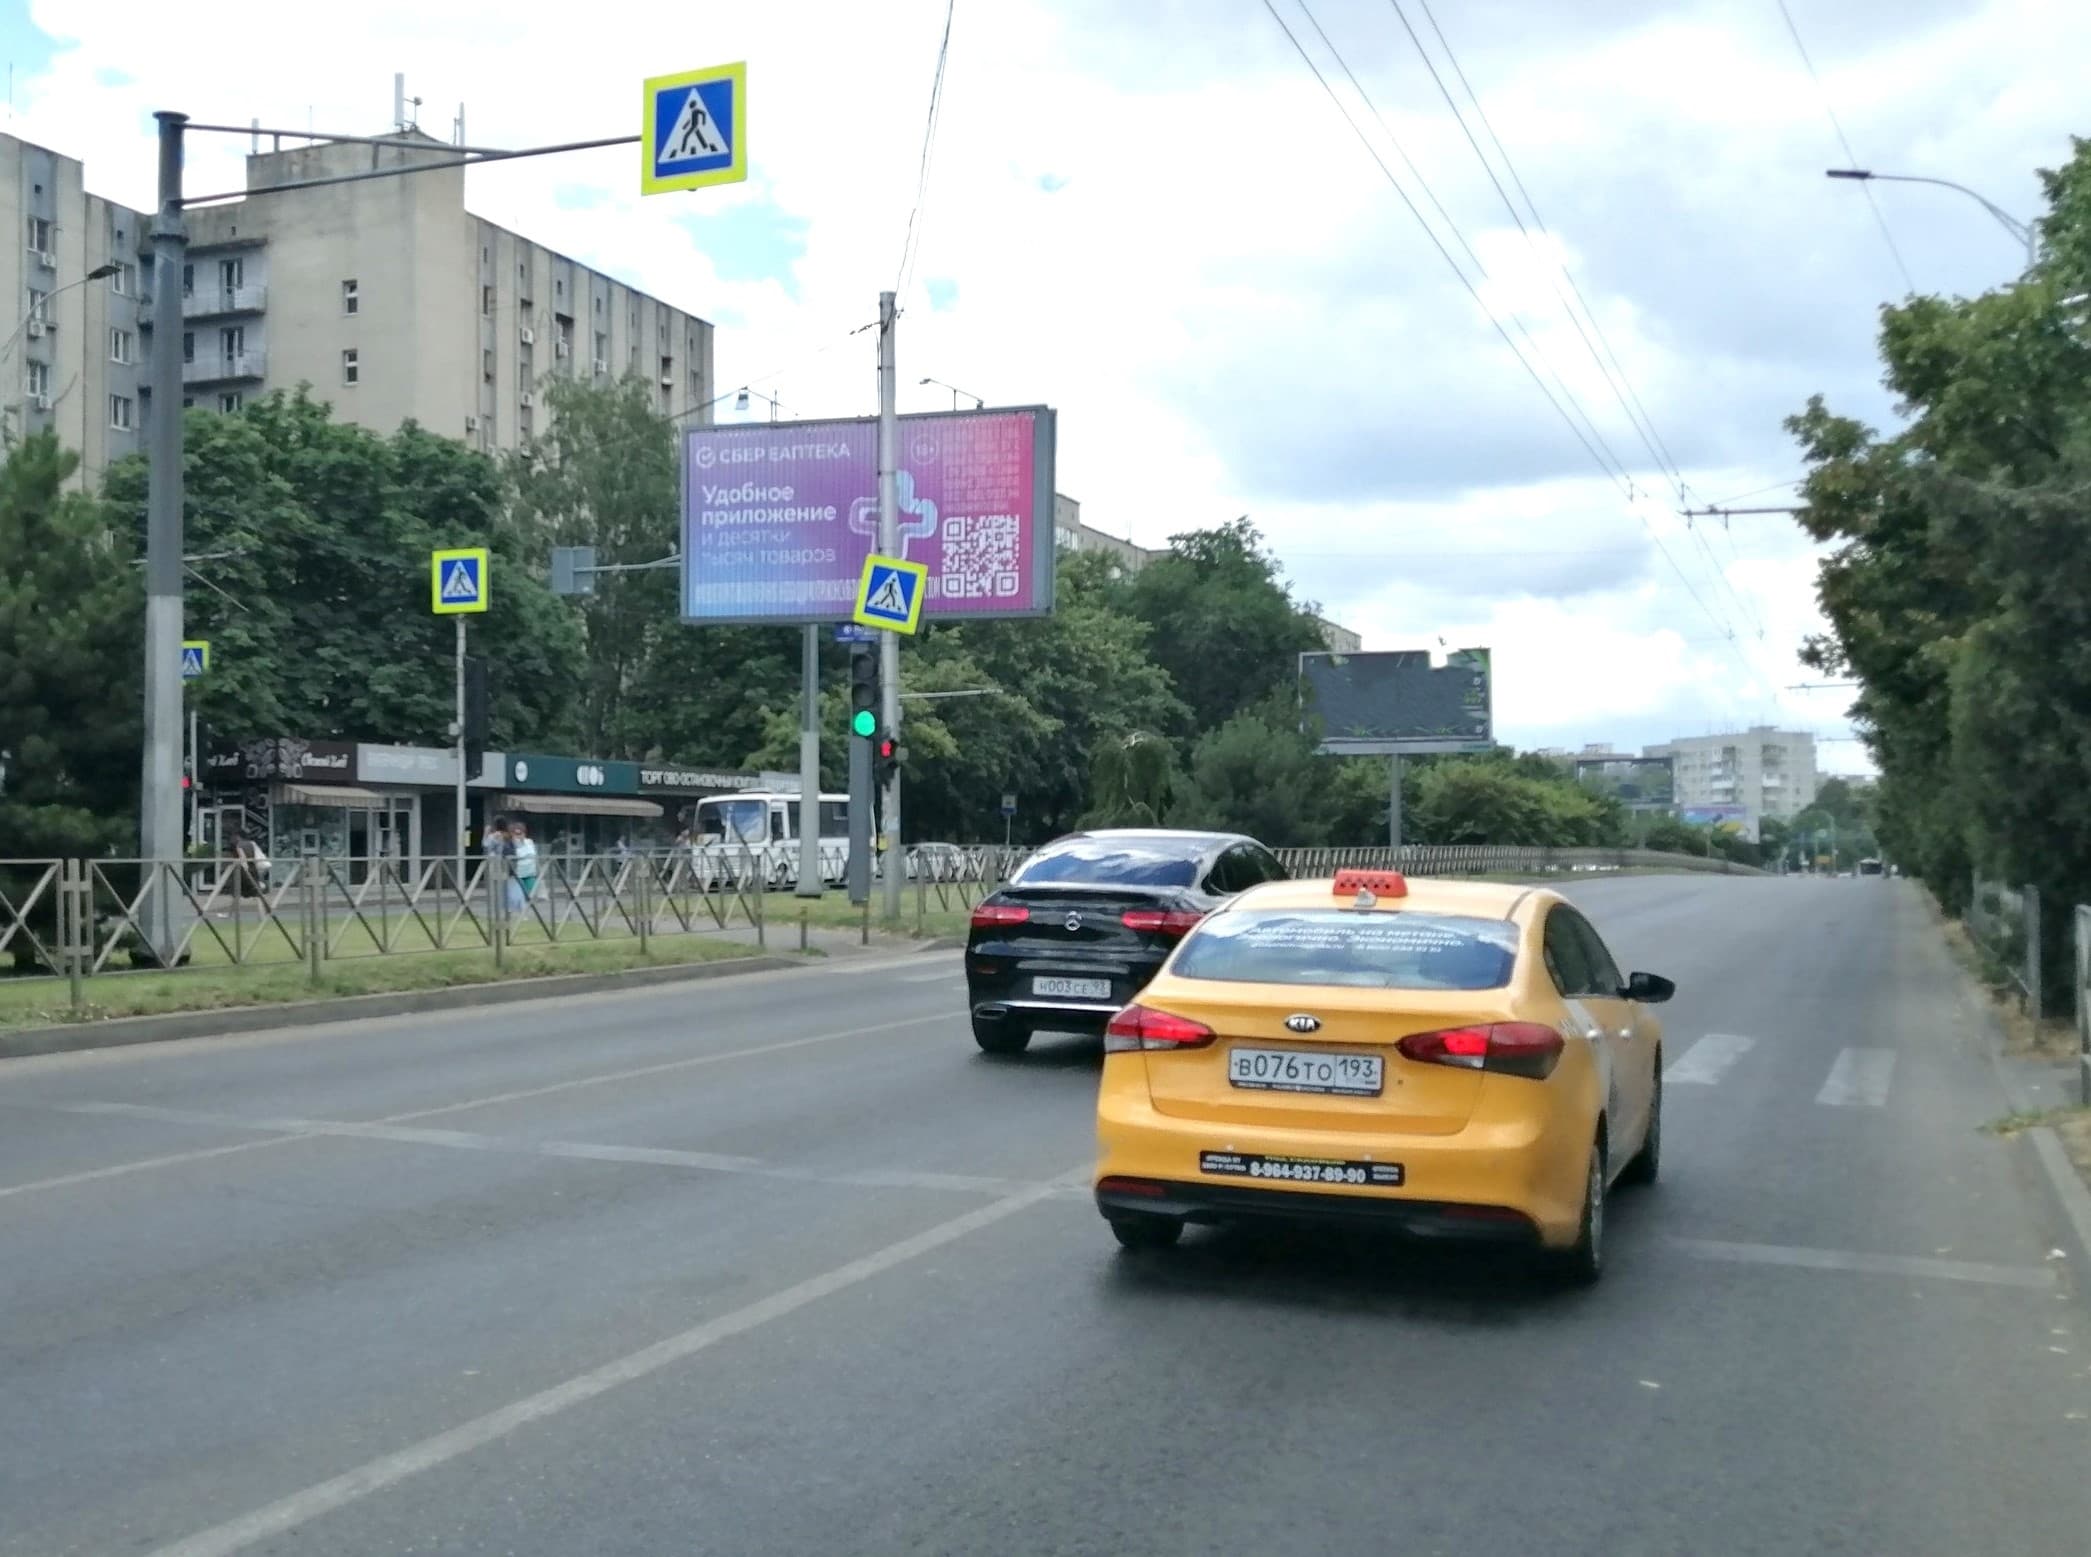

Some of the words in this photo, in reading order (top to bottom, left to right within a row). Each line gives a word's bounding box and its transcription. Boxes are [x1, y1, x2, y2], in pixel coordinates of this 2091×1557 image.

[719, 446, 765, 464] СБЕР
[768, 442, 850, 462] ЕАПТЕКА
[701, 481, 795, 507] Удобное
[701, 505, 837, 529] приложение
[760, 548, 837, 566] товаров
[1288, 1016, 1317, 1032] KIA
[1238, 1054, 1333, 1082] В076ТО
[1338, 1058, 1374, 1078] 193
